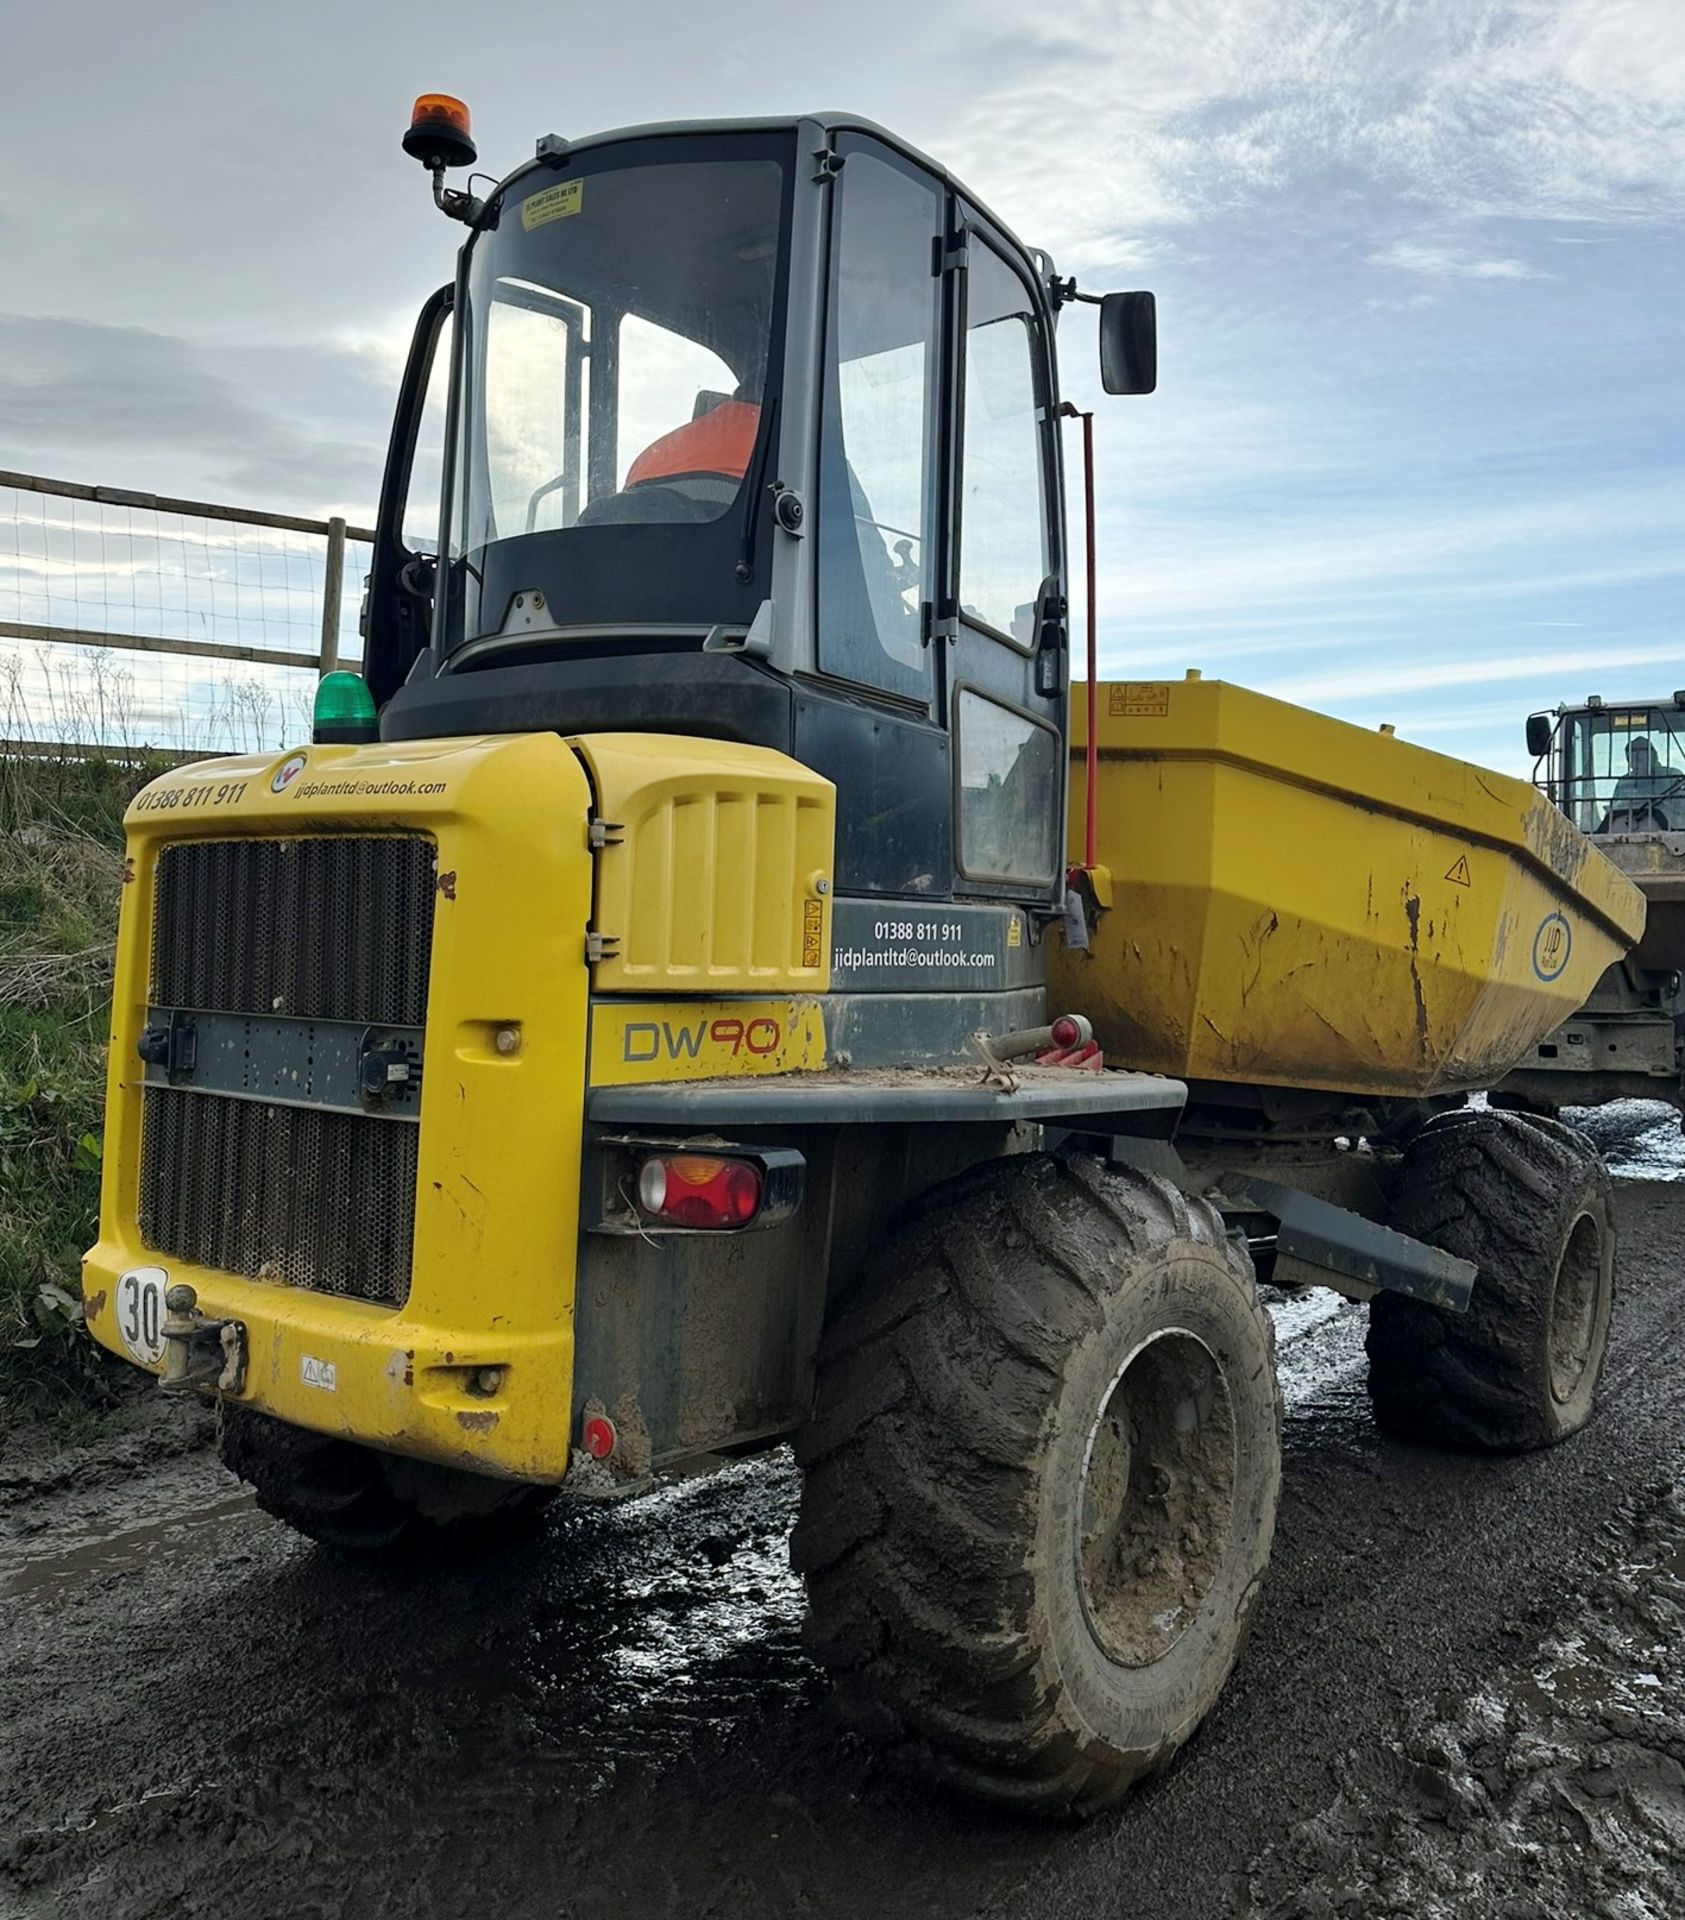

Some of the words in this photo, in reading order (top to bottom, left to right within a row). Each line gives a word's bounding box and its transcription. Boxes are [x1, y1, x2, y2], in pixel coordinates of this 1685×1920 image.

[545, 192, 560, 203] SALES
[136, 788, 181, 811] 01388
[182, 785, 214, 808] 811
[213, 782, 249, 806] 911
[293, 780, 448, 800] jjdplantltd@outlook.com
[874, 921, 913, 940] 01388
[916, 922, 937, 941] 811
[942, 923, 962, 941] 911
[623, 1018, 781, 1062] DW90
[125, 1276, 159, 1348] 30
